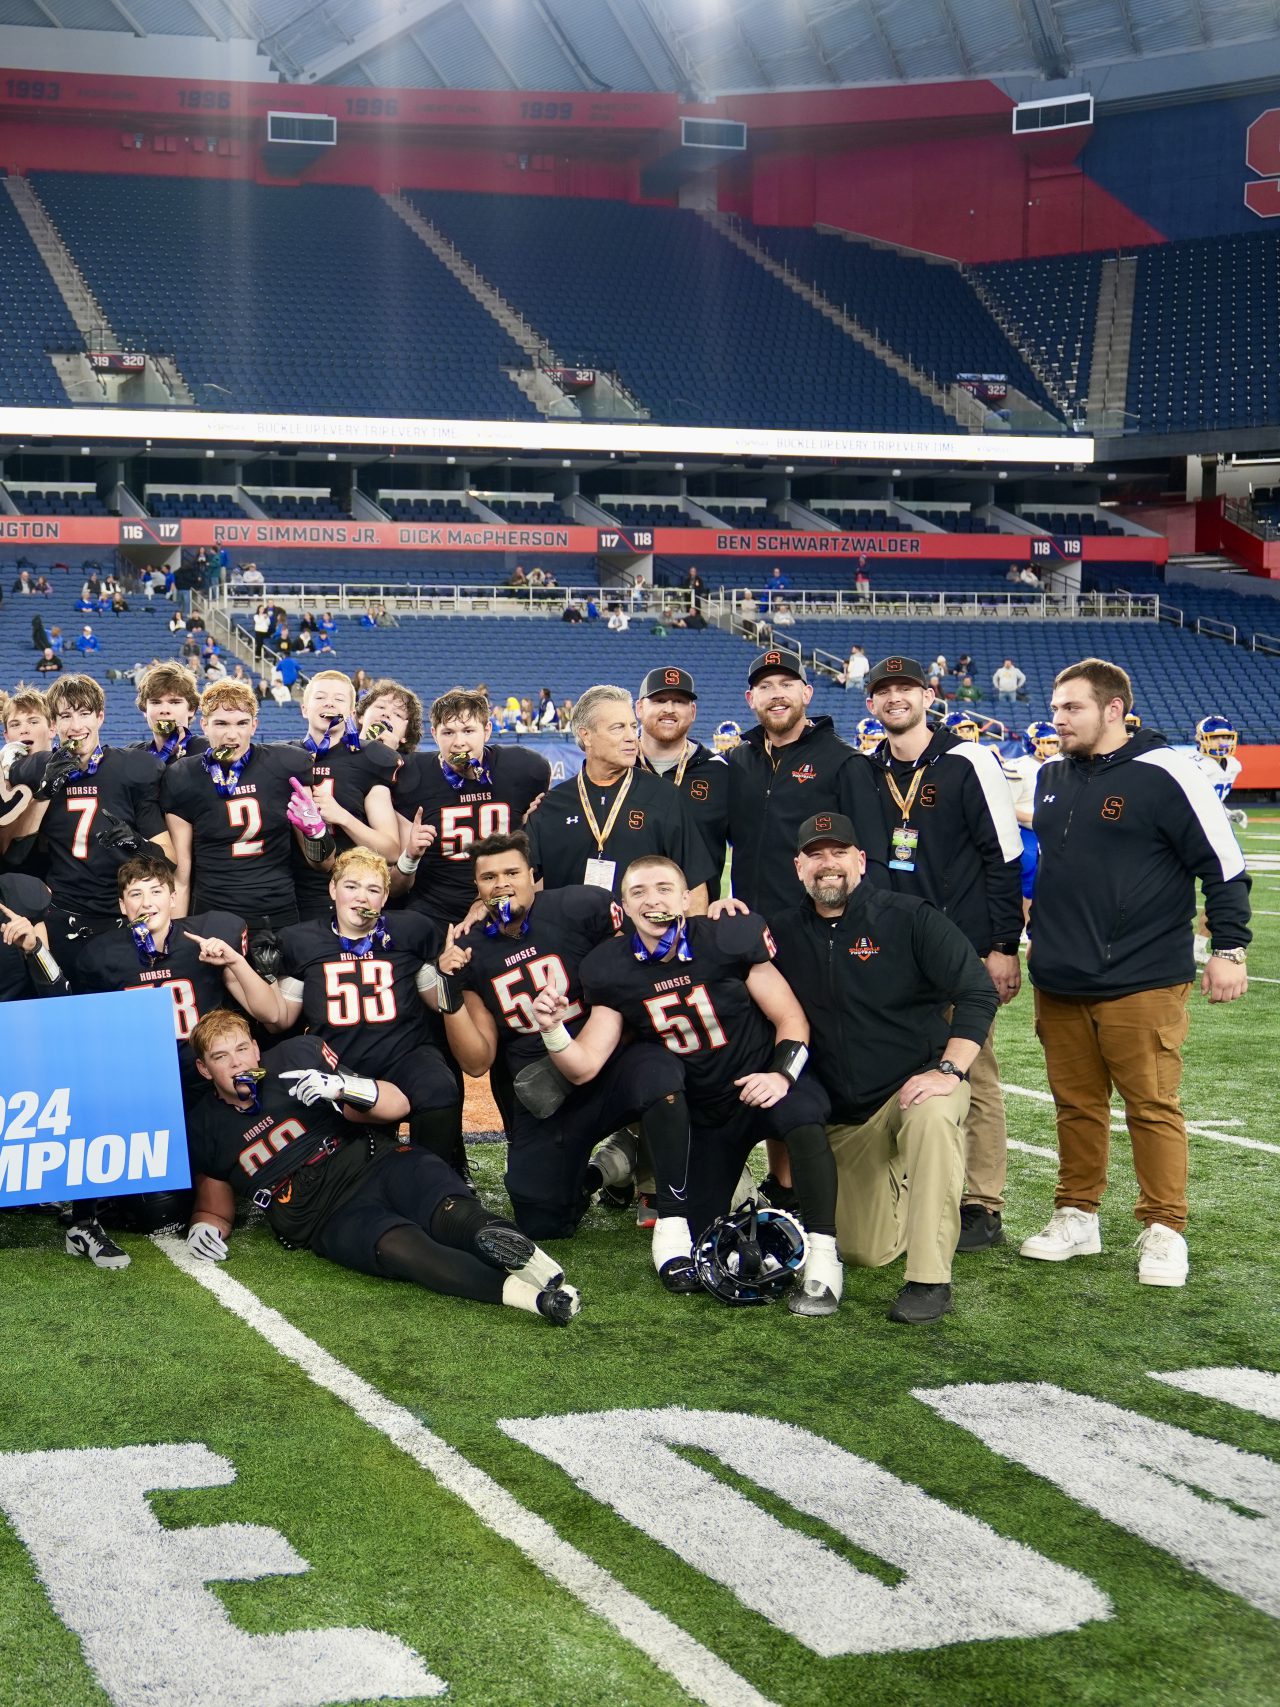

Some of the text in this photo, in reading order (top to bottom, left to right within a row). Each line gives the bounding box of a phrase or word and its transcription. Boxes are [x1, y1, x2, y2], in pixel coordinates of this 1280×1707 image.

[6, 79, 60, 101] 1993
[521, 101, 572, 120] 1999
[122, 355, 144, 366] 320
[575, 370, 593, 381] 321
[987, 385, 1006, 395] 322
[256, 422, 302, 434] BUCKLE
[322, 424, 360, 437] EVERY
[391, 427, 427, 439] EVERY
[122, 525, 143, 539] 116
[158, 524, 179, 537] 117
[214, 525, 380, 543] ROY SIMMONS JR.
[399, 529, 442, 544] DICK
[634, 532, 652, 546] 118
[600, 534, 619, 547] 117
[717, 535, 920, 554] BEN SCHWARTZWALDER
[1033, 541, 1050, 555] 118
[1063, 540, 1080, 553] 119
[765, 651, 781, 666] S
[886, 658, 903, 672] S
[664, 669, 681, 685] S
[66, 785, 98, 796] HORSES
[460, 792, 493, 804] HORSES
[690, 780, 709, 801] S
[921, 784, 937, 807] S
[1101, 796, 1124, 820] S
[66, 796, 99, 860] 7
[225, 796, 265, 858] 2
[629, 810, 645, 830] S
[504, 946, 539, 968] HORSES
[139, 968, 172, 982] HORSES
[654, 975, 692, 993] HORSES
[323, 959, 397, 1027] 53
[125, 978, 200, 1040] 8
[643, 984, 729, 1055] 51
[243, 1116, 275, 1143] HORSES
